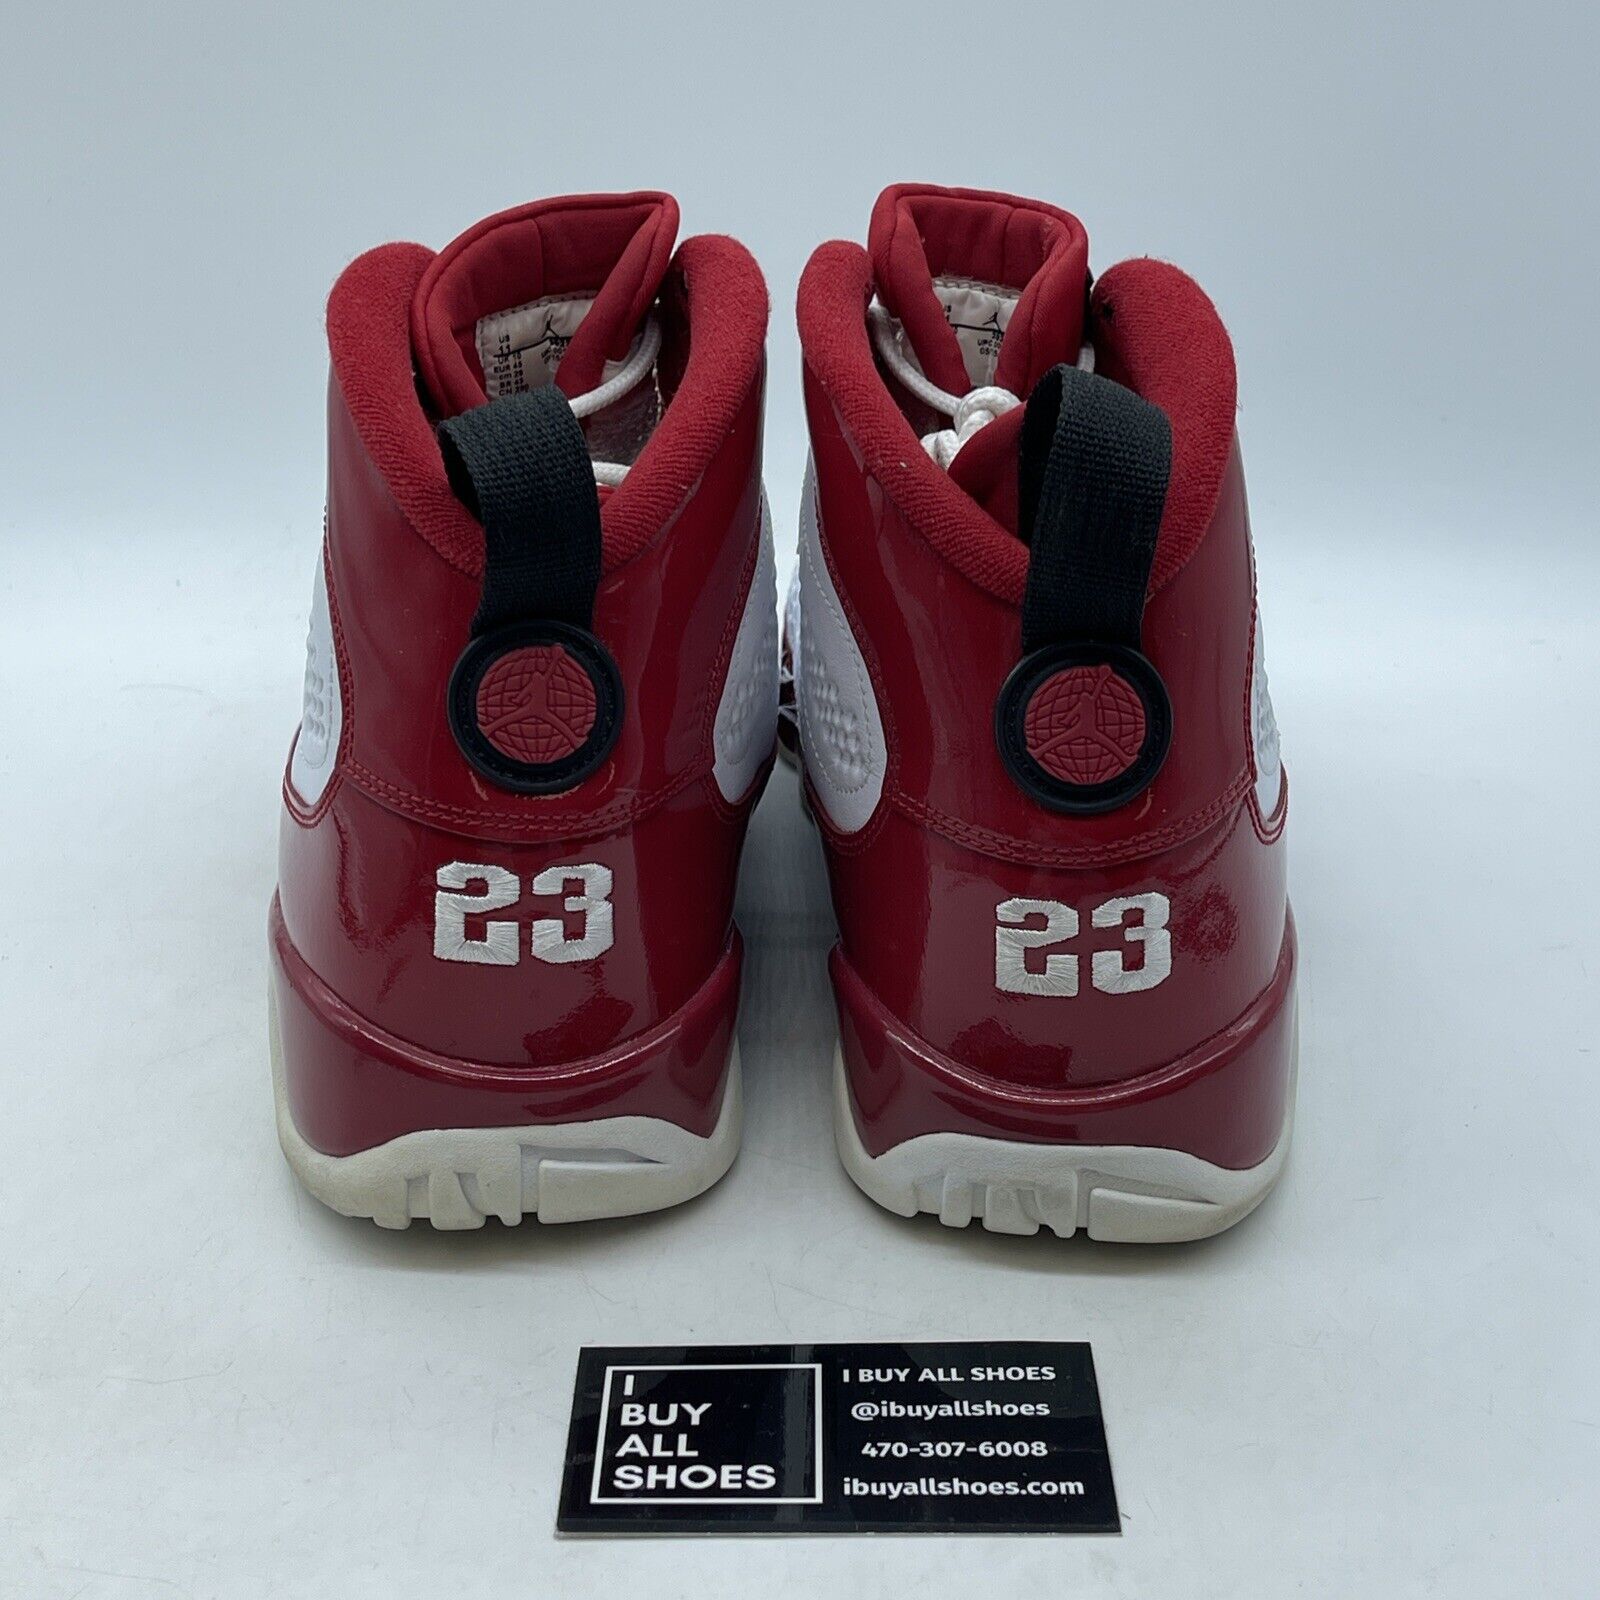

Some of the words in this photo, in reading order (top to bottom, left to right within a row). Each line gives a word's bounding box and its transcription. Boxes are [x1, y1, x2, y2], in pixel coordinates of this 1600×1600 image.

[493, 364, 511, 374] EUR
[433, 860, 615, 966] 23
[994, 891, 1173, 998] 23
[622, 1374, 635, 1396] I
[842, 1368, 850, 1383] I
[858, 1368, 910, 1383] BUY
[918, 1367, 965, 1382] ALL
[970, 1366, 1056, 1381] SHOES
[619, 1402, 712, 1427] BUY
[851, 1399, 1051, 1421] @ibuyallshoes
[615, 1433, 699, 1458] ALL
[860, 1441, 1049, 1458] 470-307-6008
[612, 1464, 776, 1490] SHOES
[842, 1477, 1085, 1500] ibuyallshoes.com
